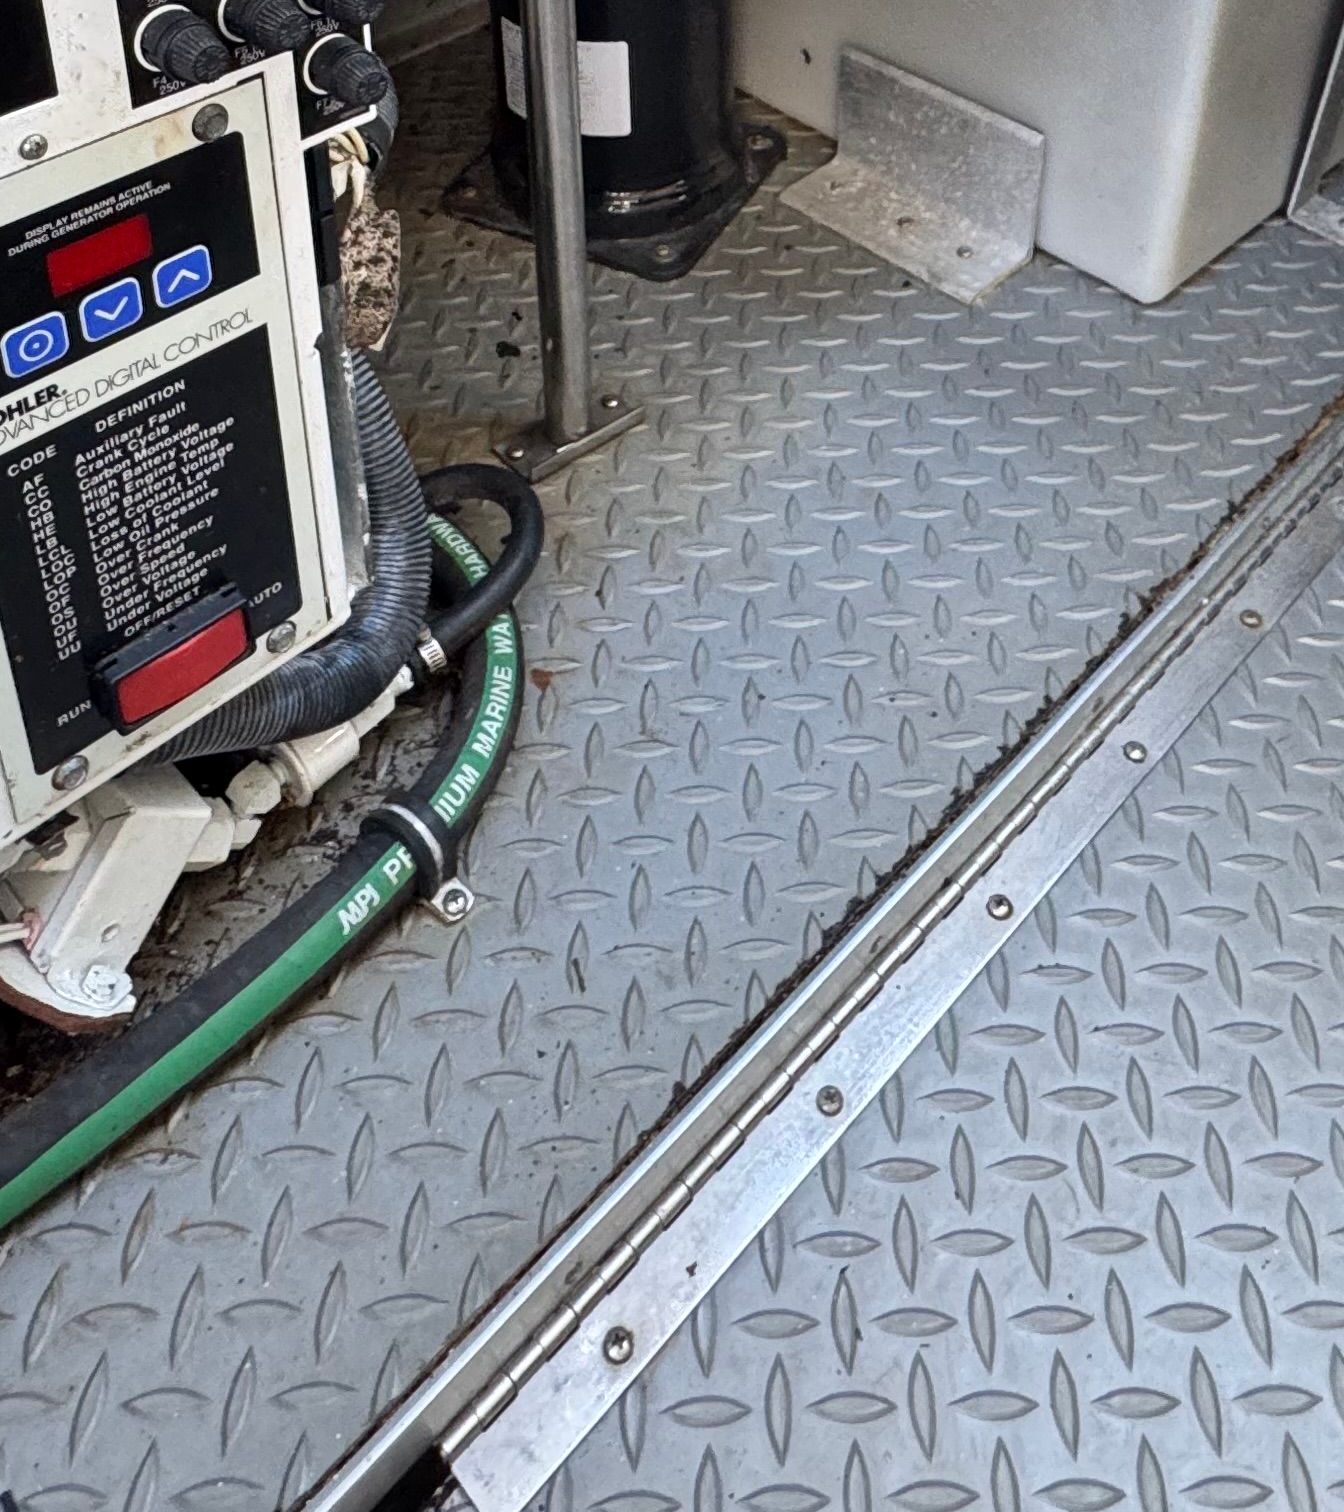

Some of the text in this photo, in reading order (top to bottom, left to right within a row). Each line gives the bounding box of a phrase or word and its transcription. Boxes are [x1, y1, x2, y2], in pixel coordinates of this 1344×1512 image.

[8, 182, 171, 257] DURING GENERATOR OPERATION
[25, 180, 153, 240] DISPLAY REMAINS ACTIVE
[95, 353, 161, 399] DIGITAL
[163, 305, 254, 361] CONTROL
[7, 378, 186, 477] CODE DEFINITION
[22, 401, 186, 494] AF Auxiliary Fault
[24, 424, 170, 505] CC Crank Cycle
[27, 422, 200, 518] CO Carbon Monoxide
[30, 417, 235, 531] HB High Battery Voltage
[33, 438, 220, 543] HE High Engine Temp
[36, 442, 234, 555] LB Low Battery Voltage
[38, 459, 225, 567] LCL Low Coolant Level
[41, 480, 208, 579] LOC Loss of Coolant
[43, 488, 219, 591] LOP Low Oil Pressure
[46, 522, 179, 602] OC Over Crank
[49, 515, 214, 614] OF Over Frequency
[51, 542, 185, 626] OS Over Speed
[54, 551, 196, 637] OU Over Voltage
[56, 544, 227, 649] UF Under Frequency
[58, 568, 208, 661] UU Under Voltage
[124, 586, 201, 637] OFF/RESET
[57, 699, 92, 727] RUN
[471, 665, 513, 758] MARINE
